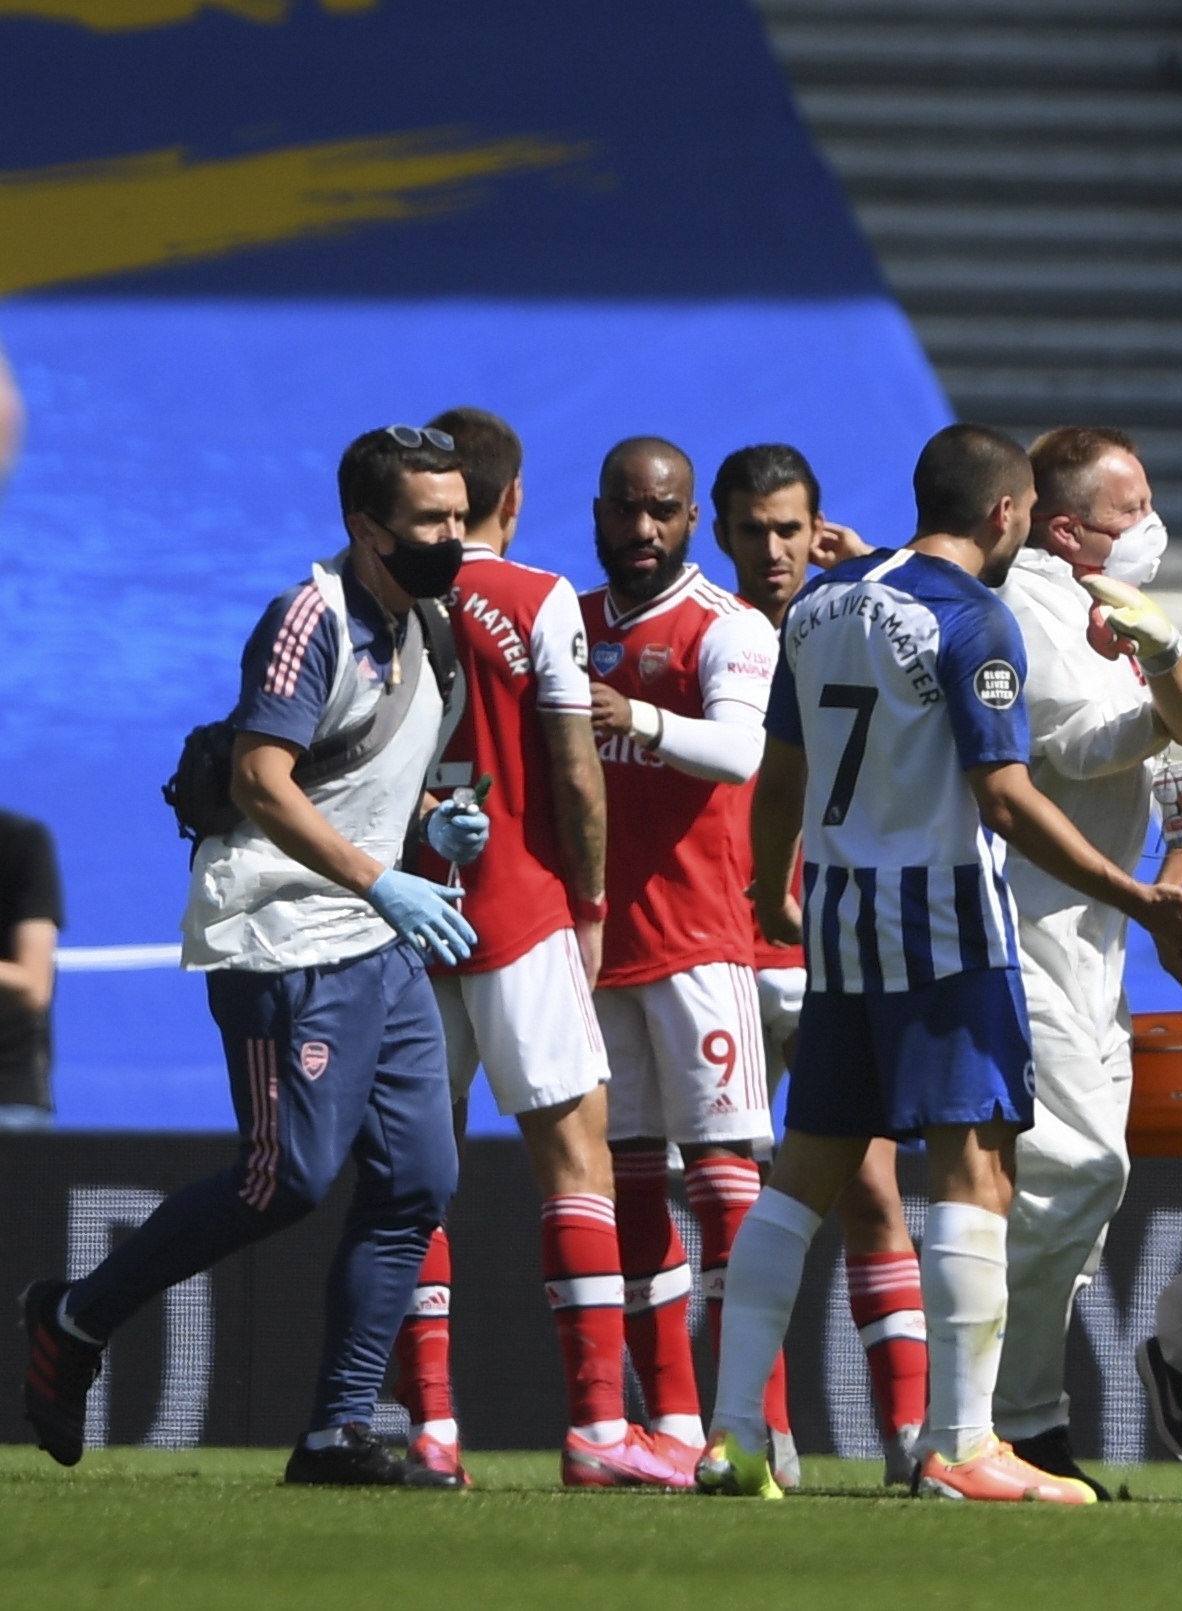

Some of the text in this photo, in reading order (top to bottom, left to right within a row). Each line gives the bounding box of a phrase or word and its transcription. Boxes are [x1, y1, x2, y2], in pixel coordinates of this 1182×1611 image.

[463, 592, 531, 676] MATTER
[829, 595, 884, 622] LIVES
[881, 613, 941, 706] MATTER
[981, 690, 1014, 700] MATTER
[818, 683, 879, 827] 7
[702, 1029, 737, 1088] 9
